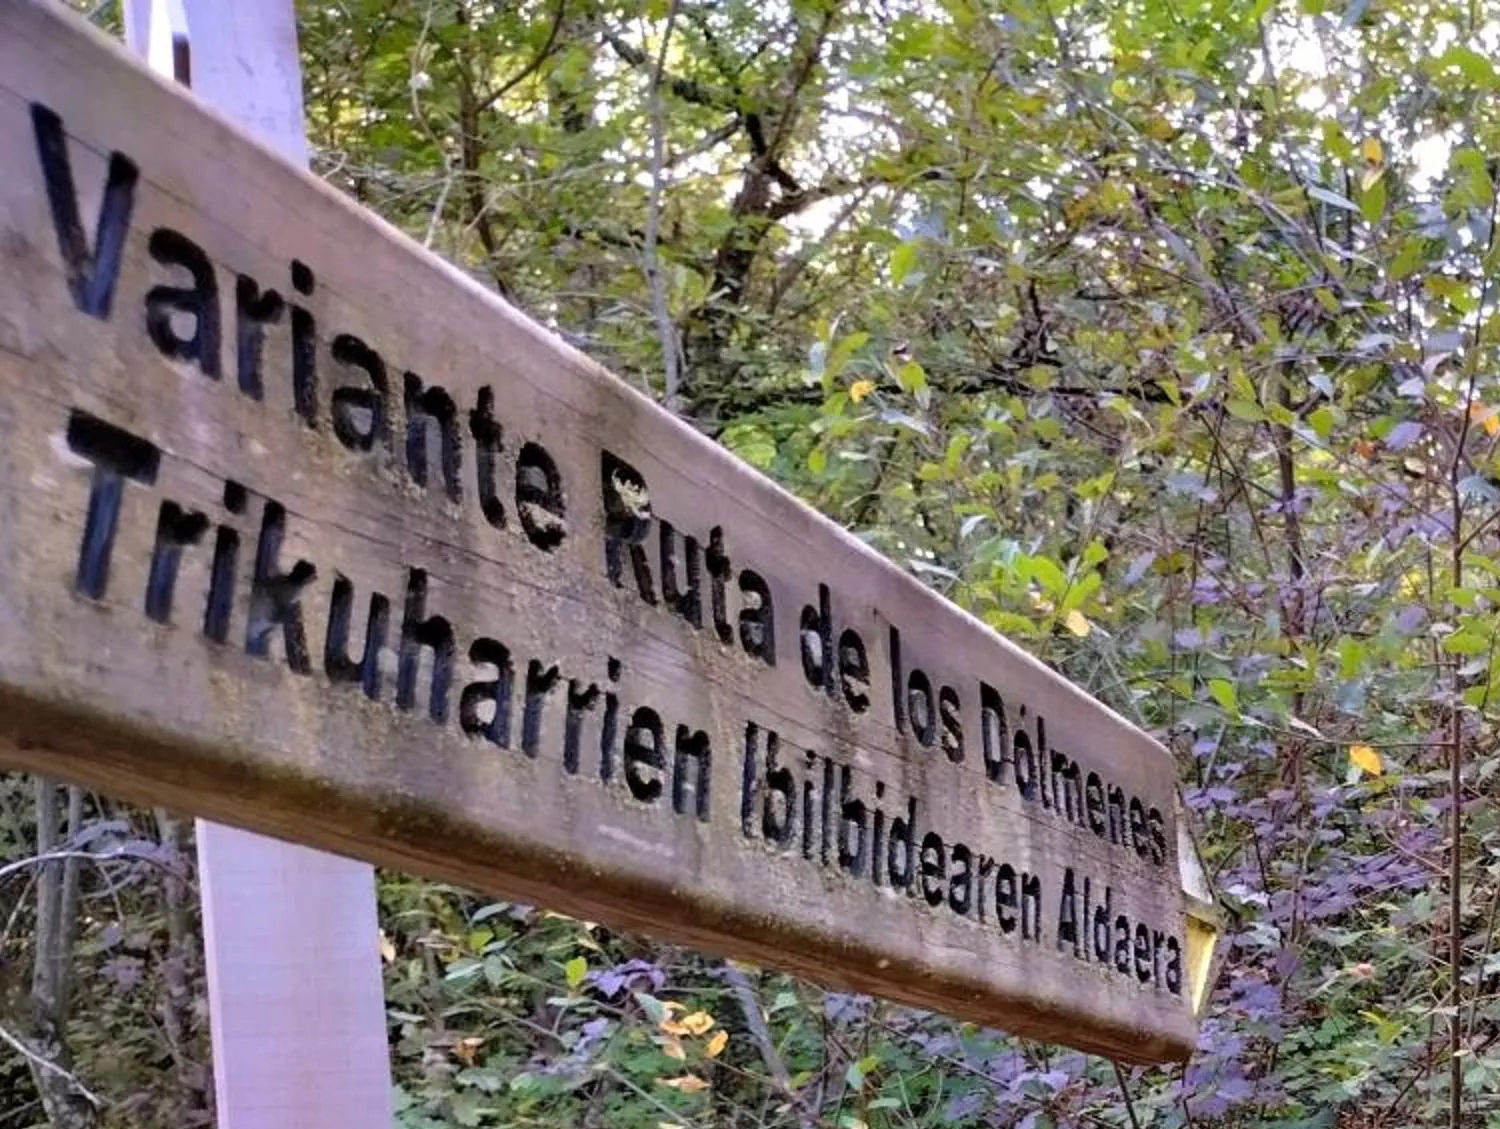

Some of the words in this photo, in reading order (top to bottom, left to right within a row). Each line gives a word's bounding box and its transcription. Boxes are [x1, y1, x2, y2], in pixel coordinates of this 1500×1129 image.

[30, 102, 566, 552] Variante
[601, 449, 776, 667] Ruta
[801, 583, 871, 713] de
[889, 624, 965, 763] los
[980, 680, 1166, 866] Dólmenes
[66, 407, 711, 823] Trikuharrien
[741, 720, 1041, 944] Ibilbidearen
[1057, 867, 1183, 995] Aldaera
